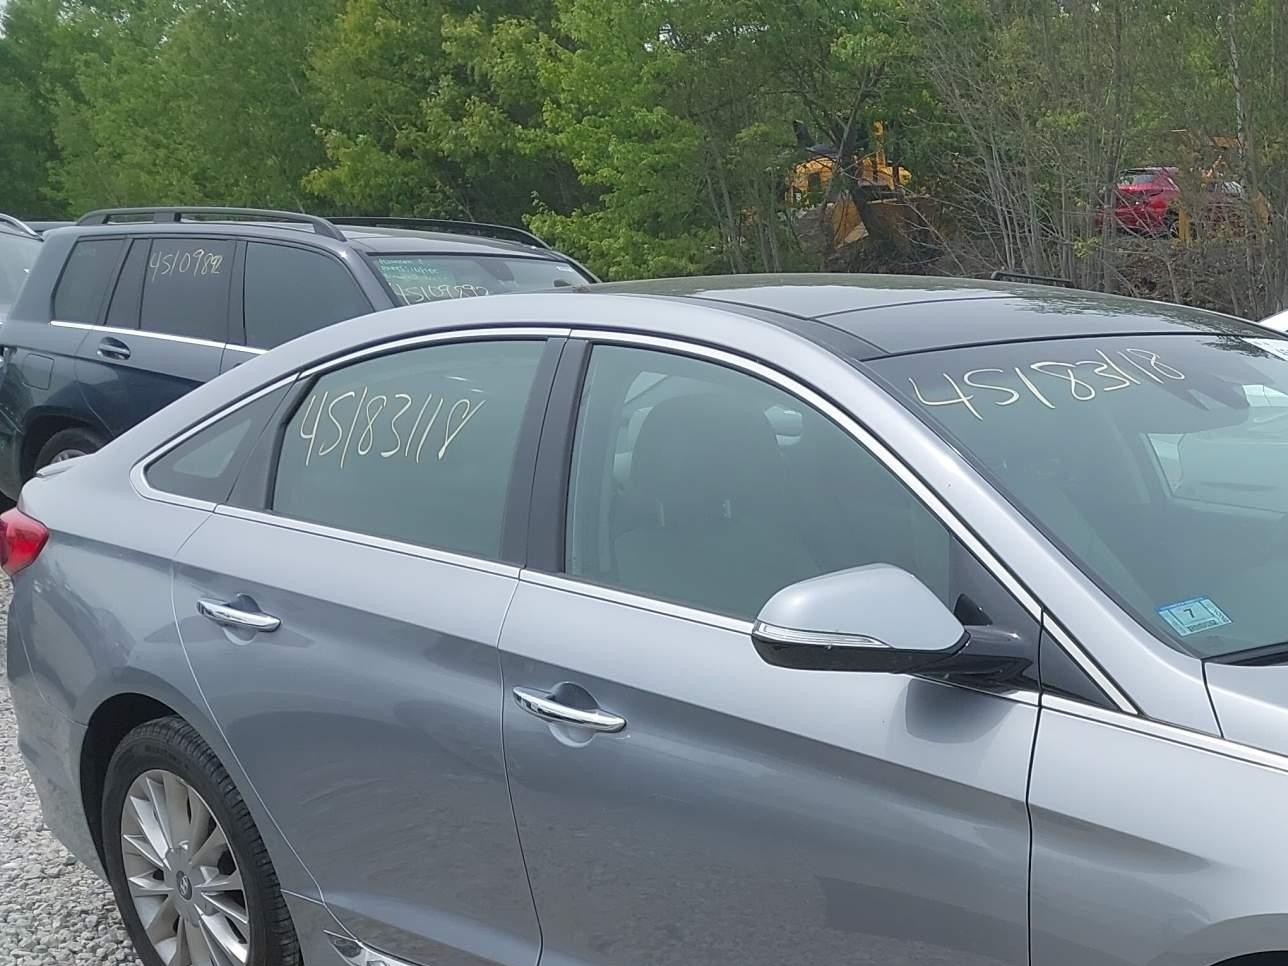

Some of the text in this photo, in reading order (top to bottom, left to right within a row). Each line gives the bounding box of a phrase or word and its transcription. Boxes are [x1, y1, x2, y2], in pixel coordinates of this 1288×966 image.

[908, 348, 1185, 420] 45183118
[300, 386, 487, 469] 45183118
[1183, 608, 1195, 618] 7
